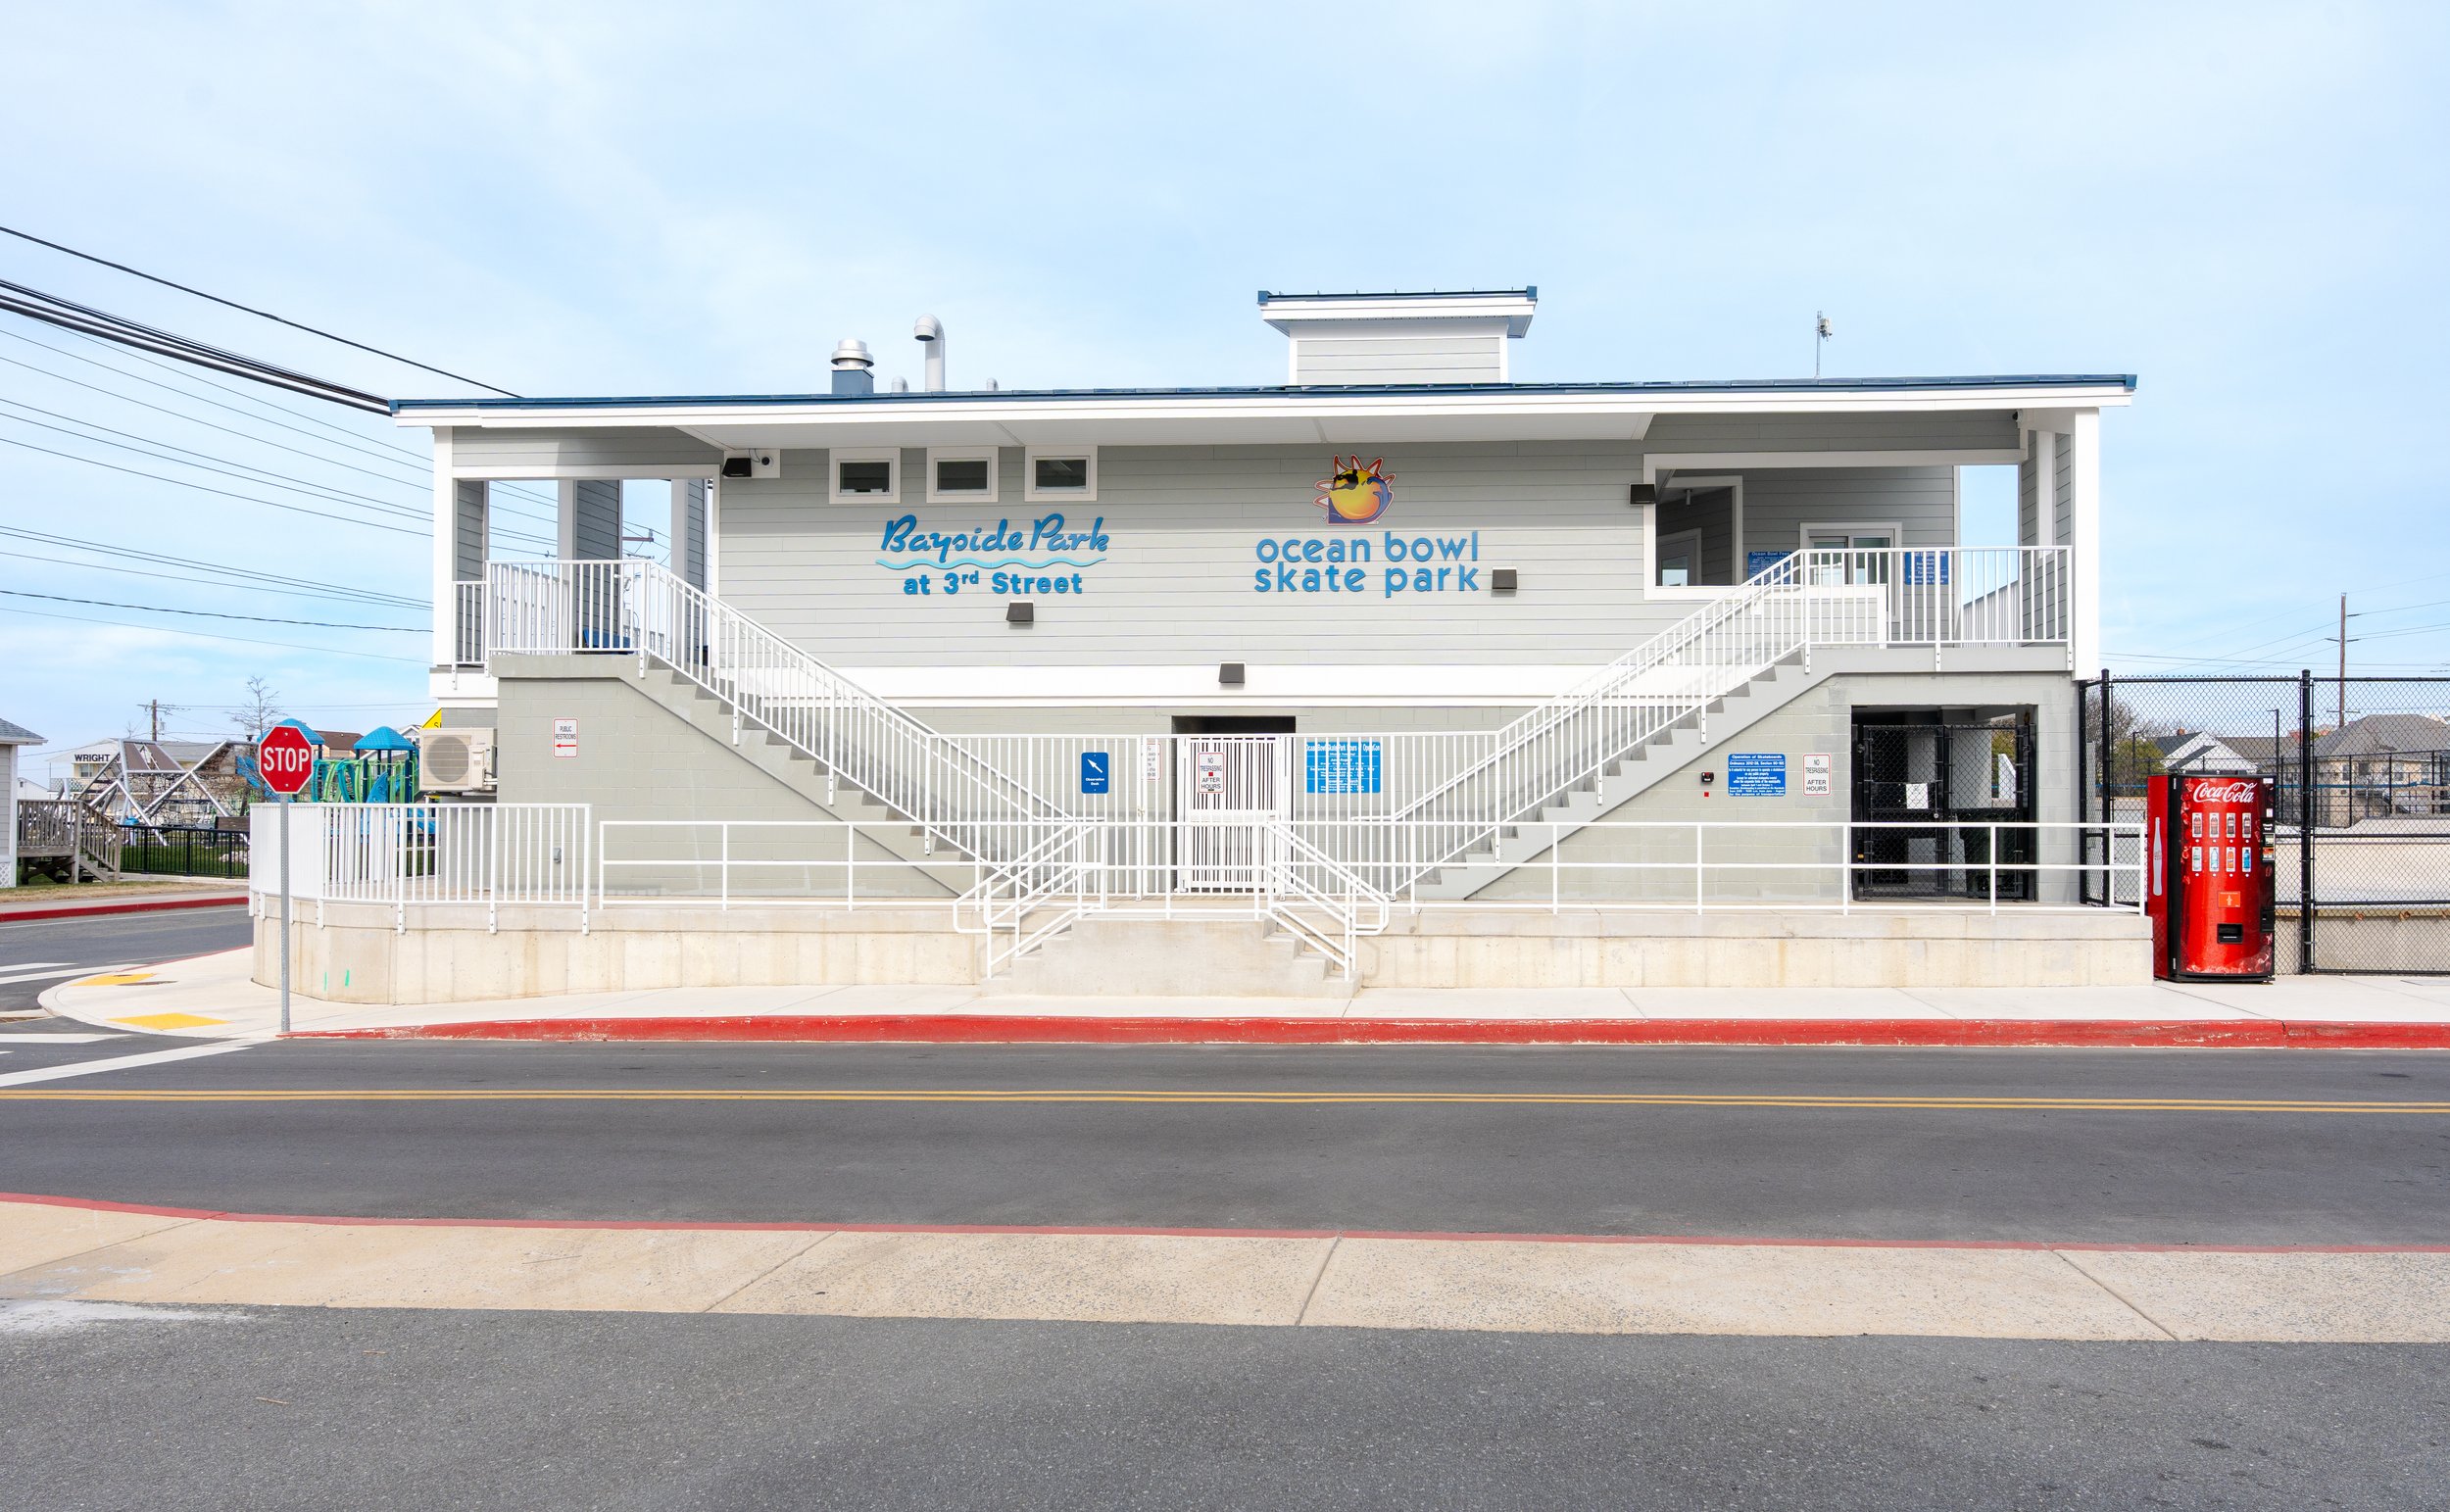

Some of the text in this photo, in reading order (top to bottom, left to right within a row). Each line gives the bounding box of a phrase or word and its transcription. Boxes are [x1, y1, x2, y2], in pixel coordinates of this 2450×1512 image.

[881, 512, 1110, 563] Bayside Park
[1255, 530, 1479, 563] ocean bowl
[903, 570, 1083, 595] at 3rd Street
[1253, 561, 1480, 599] skate park
[263, 746, 310, 772] STOP
[2192, 782, 2258, 804] Coca-Cola
